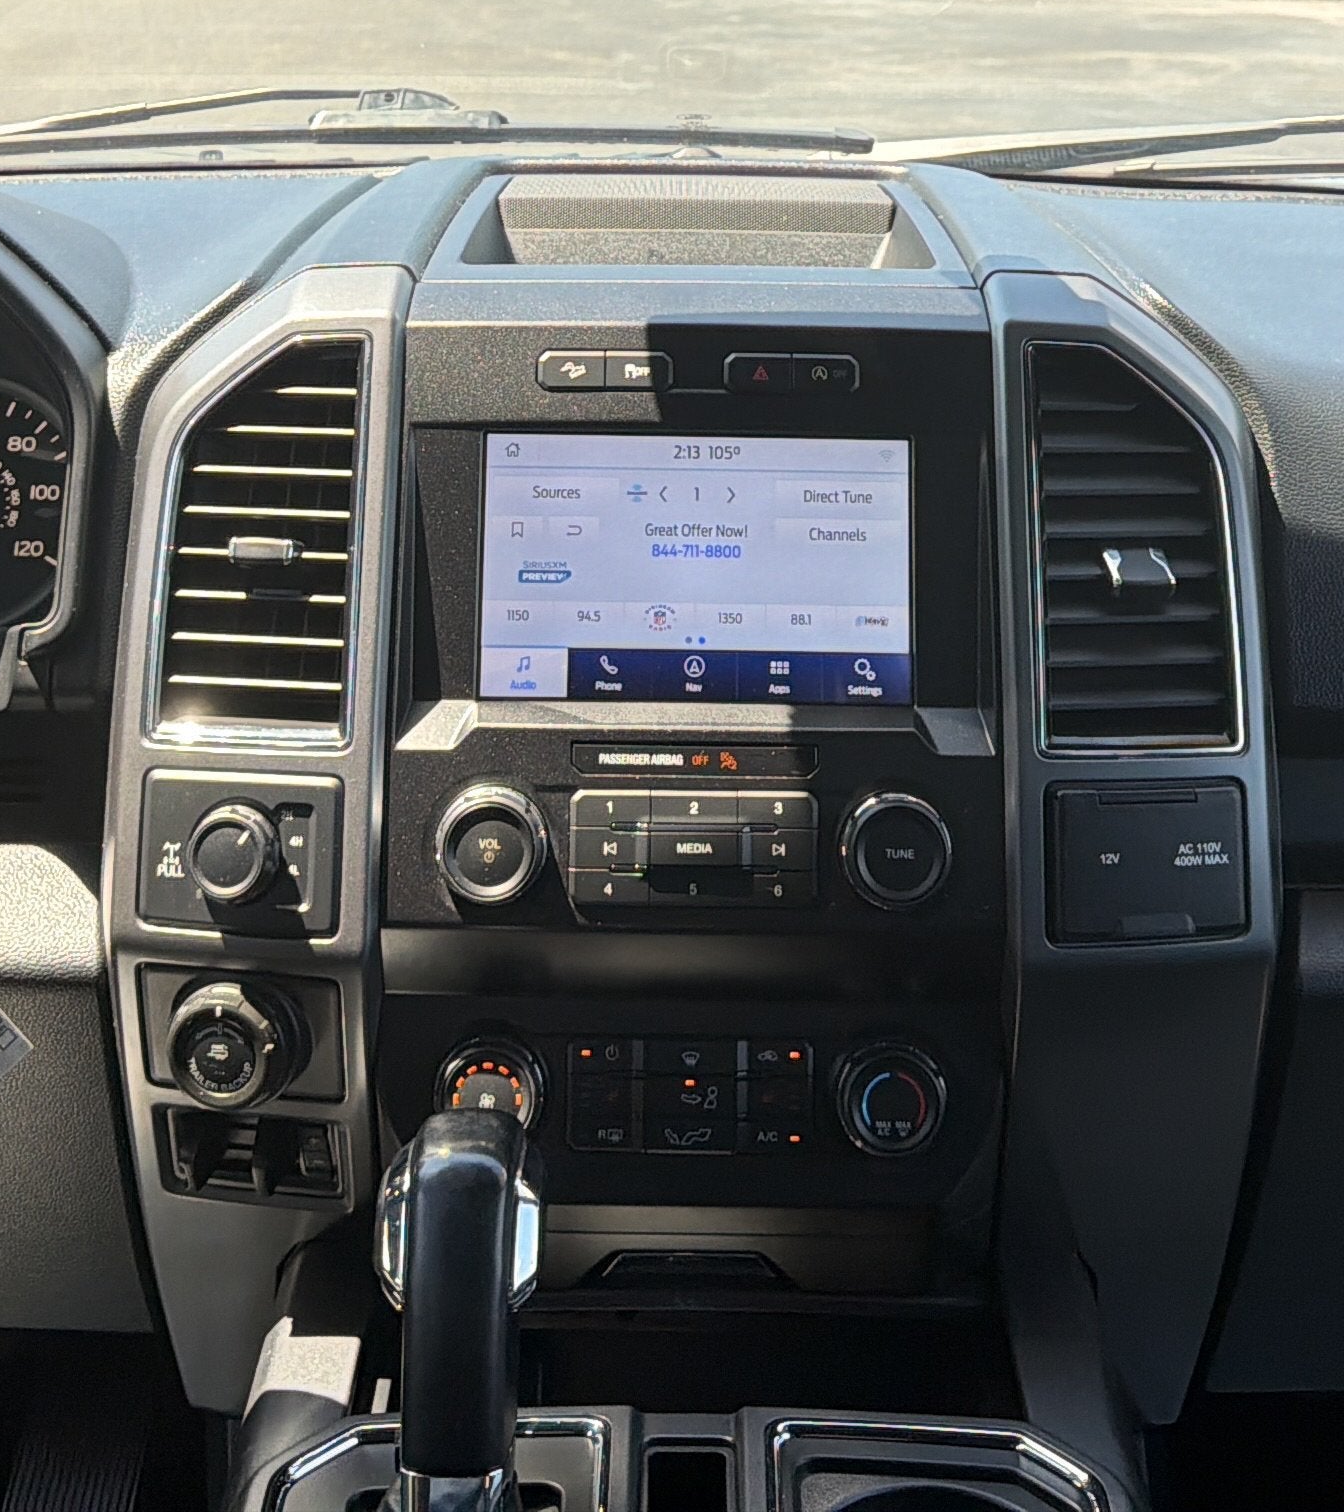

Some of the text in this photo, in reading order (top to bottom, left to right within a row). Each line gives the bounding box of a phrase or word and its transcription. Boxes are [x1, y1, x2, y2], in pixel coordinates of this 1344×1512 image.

[6, 436, 36, 452] 80
[673, 445, 701, 460] 2:13
[29, 484, 60, 501] 100
[532, 484, 581, 500] Sources
[803, 488, 839, 504] Direct
[841, 490, 873, 504] Tune
[644, 523, 867, 543] Great Offer Now! Channels
[13, 540, 44, 558] 120
[651, 543, 742, 559] 844-711-8800
[506, 609, 812, 626] 1150 94.5 1350 88.1
[509, 679, 883, 698] Audio Phone Nav Apps Settings
[598, 752, 709, 767] PASSENGER AIRBAG OFF
[605, 800, 784, 816] 1 2 3
[478, 838, 916, 861] VOL MEDIA TUNE
[1099, 841, 1222, 865] 12V AC 110V
[1173, 853, 1230, 867] 400W MAX
[156, 863, 185, 879] PULL
[603, 883, 783, 897] 4 5 6
[187, 1056, 253, 1091] TRAILER BACKUP
[875, 1120, 912, 1129] MAX MAX
[757, 1130, 779, 1144] A/C
